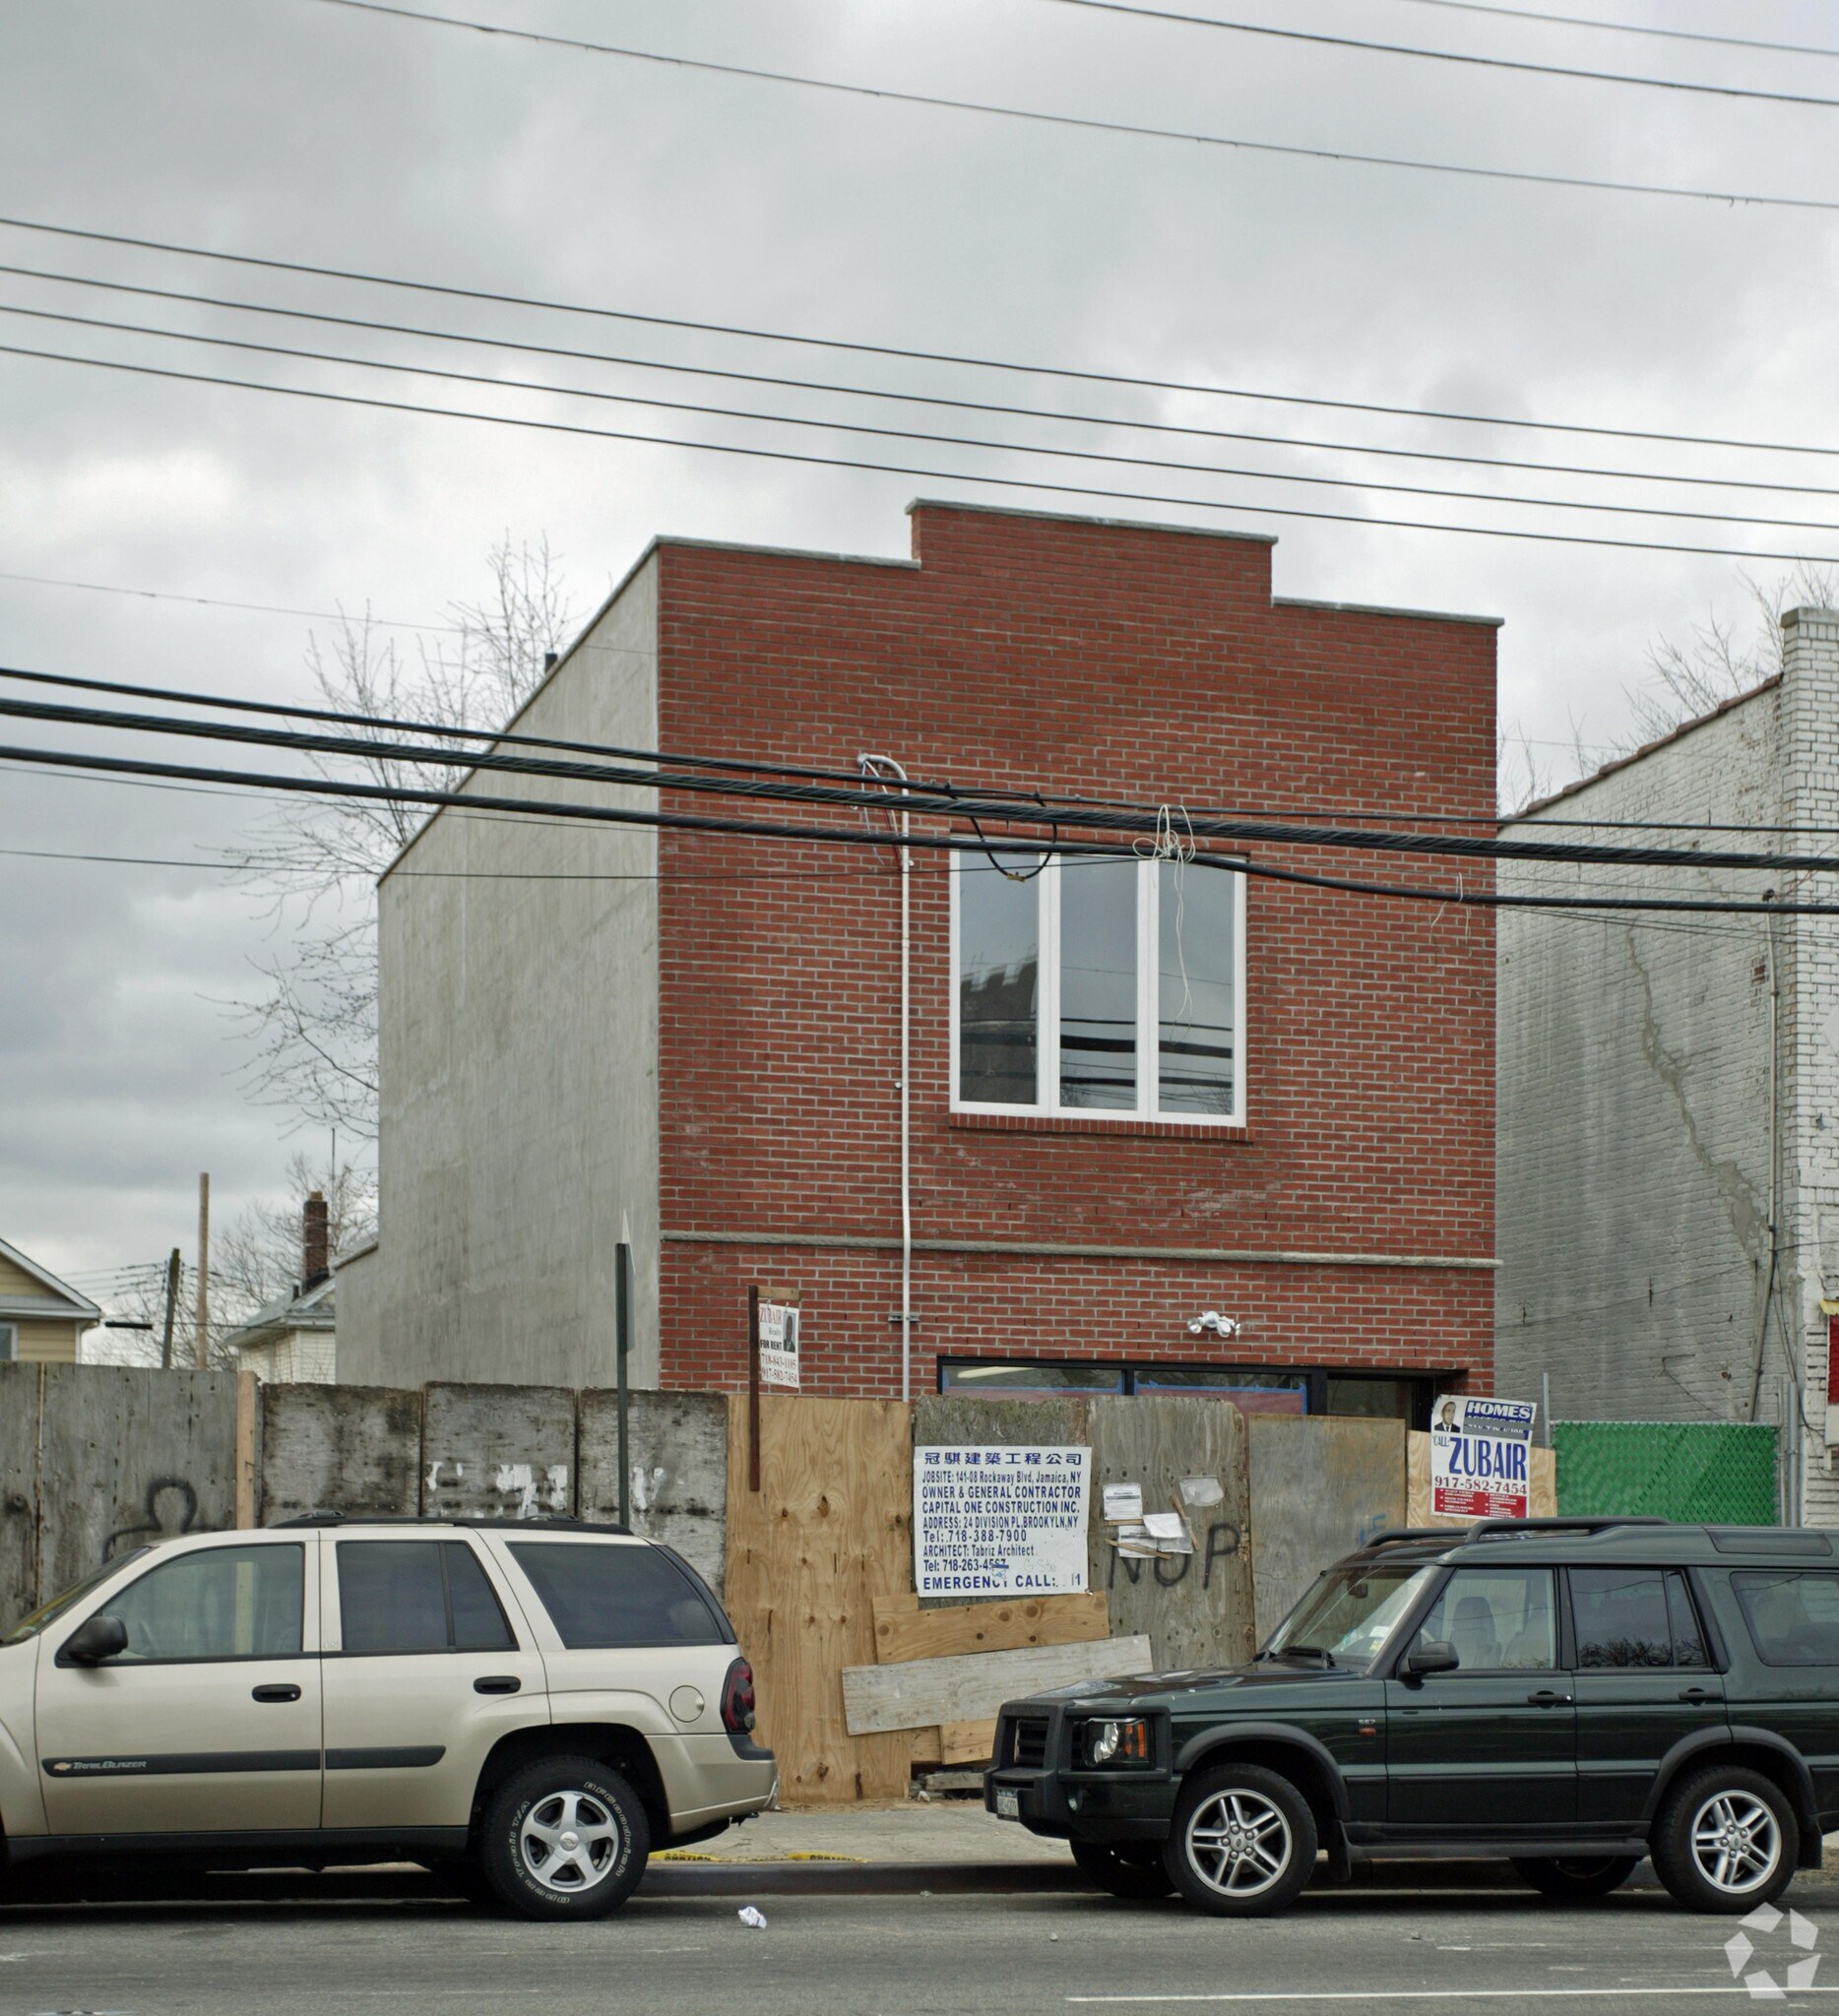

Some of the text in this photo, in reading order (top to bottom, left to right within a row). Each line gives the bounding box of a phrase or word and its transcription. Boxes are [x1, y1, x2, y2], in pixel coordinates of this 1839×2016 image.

[760, 1339, 782, 1351] FOR RENT
[1467, 1402, 1531, 1418] HOMES
[1449, 1437, 1527, 1480] ZUBAIR
[922, 1472, 954, 1483] JOBSITE:
[956, 1471, 978, 1482] 141-08
[980, 1472, 1014, 1485] Rockaway
[1036, 1472, 1068, 1484] Jamaica,
[1070, 1472, 1081, 1482] NY
[922, 1485, 1081, 1498] OWNER & GENERAL CONTRACTOR
[1435, 1476, 1527, 1494] 917-582-7454
[922, 1501, 1080, 1514] CAPITAL ONE CONSTRUCTION INC.
[923, 1517, 962, 1529] ADDRESS:
[964, 1517, 973, 1528] 24
[975, 1517, 1009, 1528] DIVISION
[923, 1530, 1027, 1543] Tel: 718-388-7900
[923, 1544, 1034, 1557] ARCHITECT: Tabriz Architect
[923, 1560, 939, 1572] Tel:
[1016, 1575, 1056, 1587] CALL:
